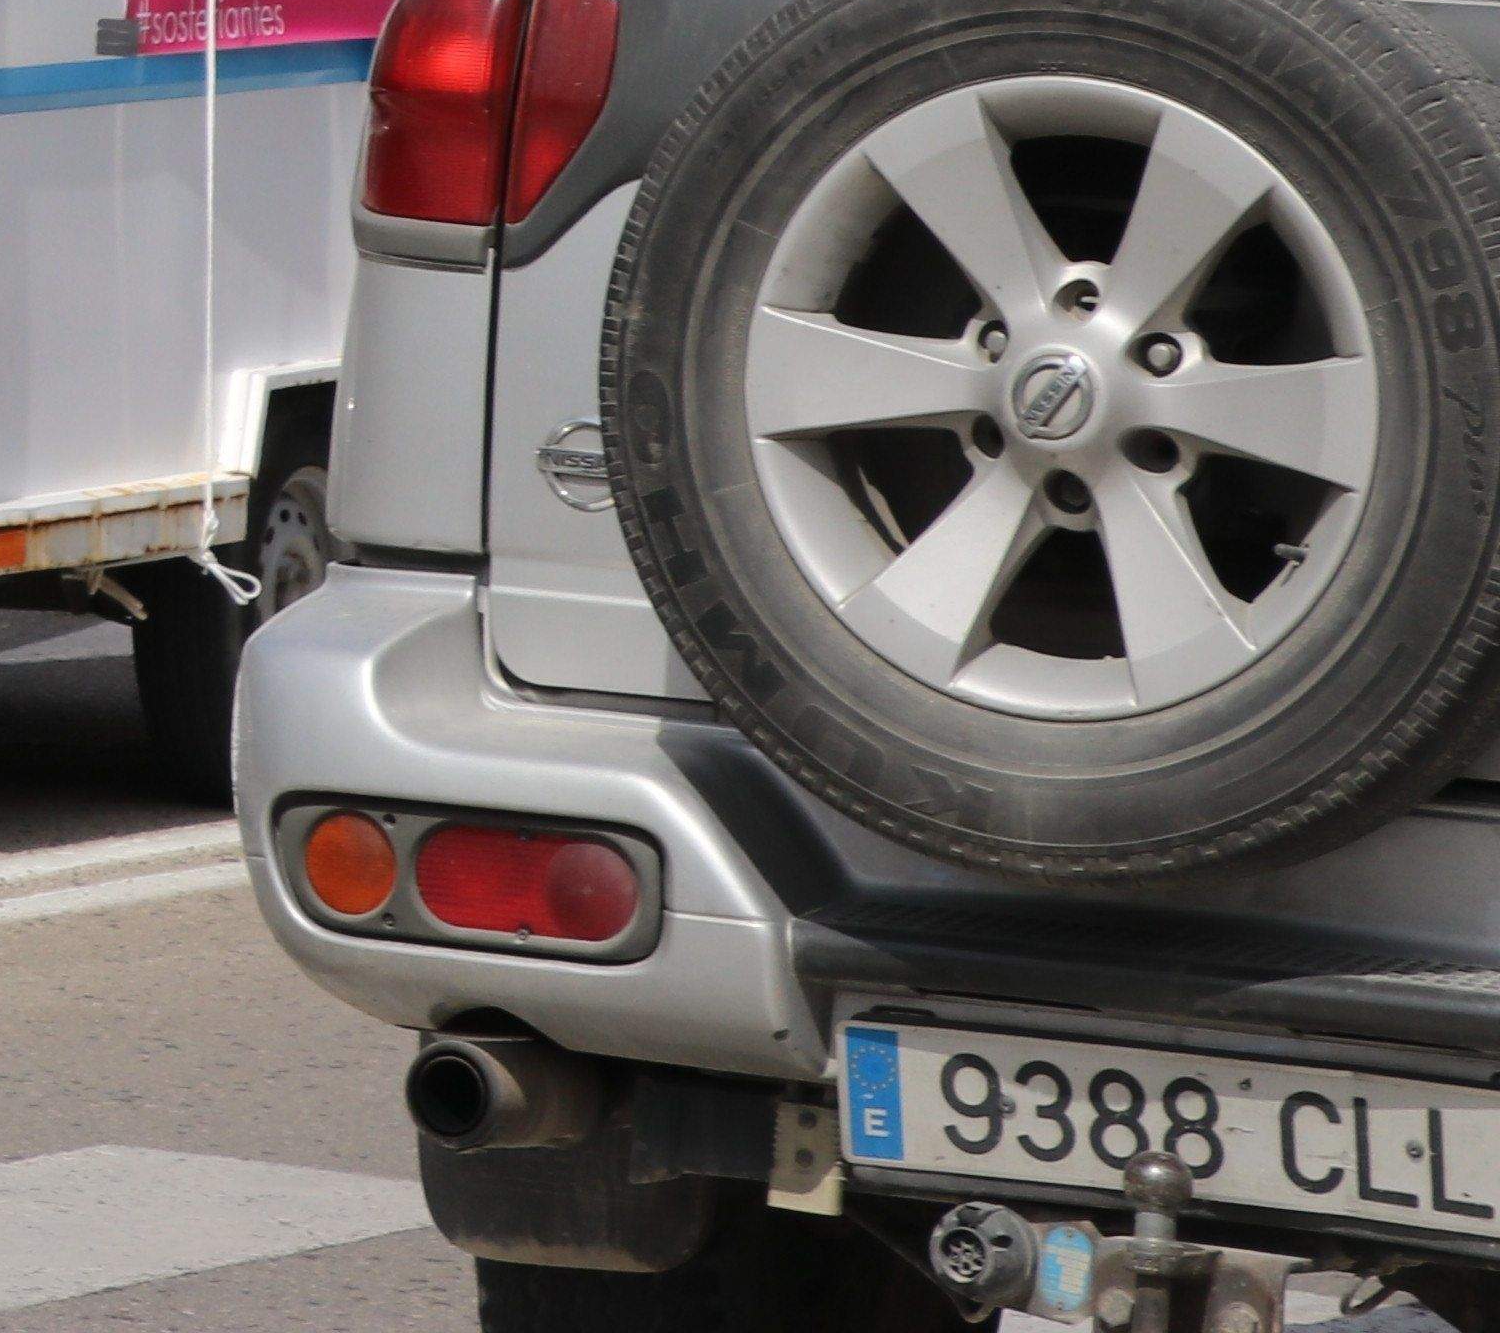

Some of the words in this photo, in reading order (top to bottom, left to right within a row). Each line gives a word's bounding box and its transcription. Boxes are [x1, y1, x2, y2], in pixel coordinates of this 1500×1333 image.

[863, 1109, 889, 1137] E
[940, 1053, 1224, 1179] 9388
[1280, 1090, 1494, 1219] CLL
